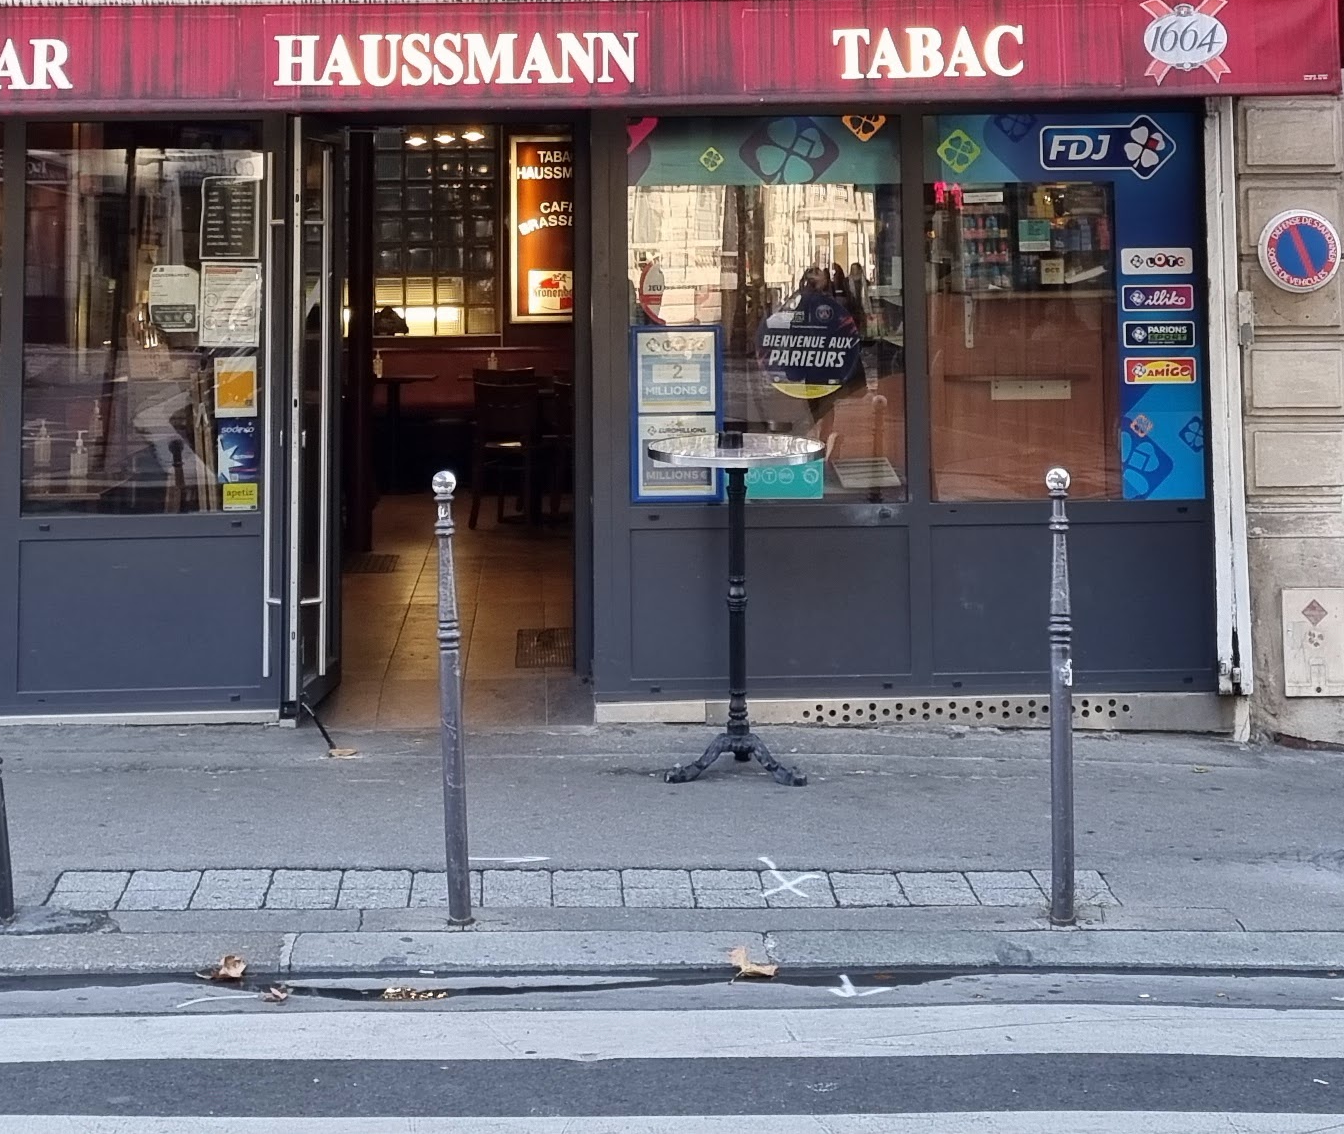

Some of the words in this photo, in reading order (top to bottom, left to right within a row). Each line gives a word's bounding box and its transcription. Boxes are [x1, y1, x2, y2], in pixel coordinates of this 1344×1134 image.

[1150, 16, 1225, 56] 1664
[273, 32, 639, 87] HAUSSMANN
[832, 24, 1024, 81] TABAC
[1049, 134, 1111, 161] FDJ
[537, 150, 572, 164] TABA
[517, 166, 572, 180] HAUSSM
[1271, 217, 1301, 240] DEFENSE
[1301, 216, 1314, 226] DE
[1146, 253, 1186, 268] LOTO
[1267, 247, 1282, 274] SORTIE
[1144, 289, 1186, 306] illiko
[1147, 326, 1187, 334] PARIONS
[1148, 333, 1187, 341] SPORT
[762, 334, 827, 349] BIENVENUE
[828, 336, 853, 349] AUX
[768, 349, 847, 368] PARIEURS
[672, 364, 683, 379] 2
[1146, 364, 1192, 377] AMIGO
[645, 386, 697, 396] MILLIONS
[658, 427, 707, 435] EUROMILLIONS
[646, 470, 698, 480] MILLIONS
[226, 488, 254, 499] apetiz
